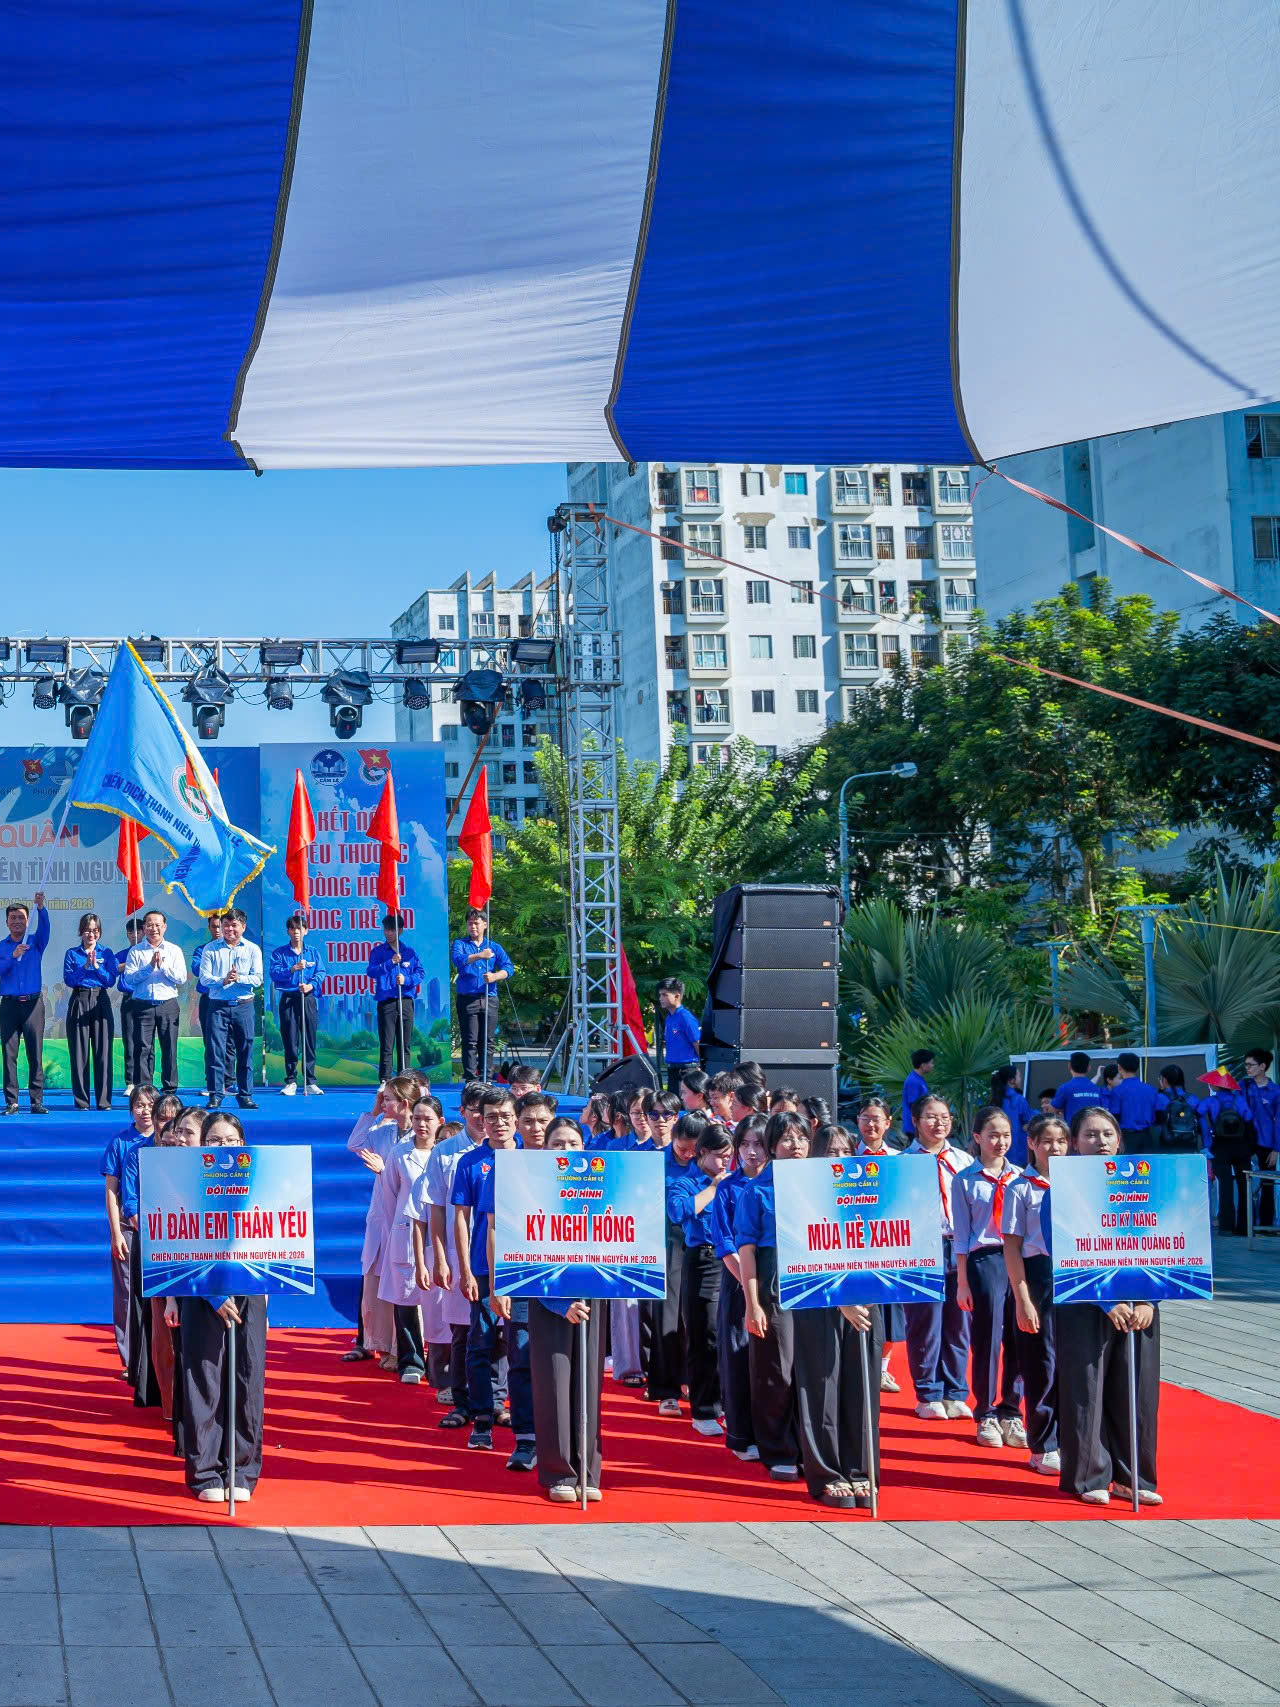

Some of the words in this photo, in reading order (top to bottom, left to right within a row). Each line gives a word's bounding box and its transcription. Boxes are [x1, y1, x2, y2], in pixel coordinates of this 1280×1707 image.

[145, 794, 174, 823] THANH
[172, 818, 194, 841] NIÊN
[318, 806, 350, 832] KẾT
[28, 857, 69, 881] TÌNH
[48, 898, 69, 910] năm
[71, 898, 94, 909] 2026
[348, 905, 381, 929] TRẺ
[206, 1185, 224, 1196] ĐỘI
[225, 1184, 249, 1194] HÌNH
[560, 1188, 578, 1200] ĐỘI
[579, 1188, 602, 1198] HÌNH
[836, 1195, 853, 1207] ĐỘI
[855, 1194, 878, 1204] HÌNH
[1109, 1192, 1125, 1204] ĐỘI
[1127, 1192, 1148, 1202] HÌNH
[148, 1207, 162, 1240] VÌ
[167, 1207, 199, 1239] ĐÀN
[205, 1212, 228, 1239] EM
[233, 1206, 273, 1239] THÂN
[278, 1206, 307, 1238] YÊU
[527, 1209, 545, 1241] KỲ
[551, 1206, 588, 1242] NGHỈ
[593, 1206, 634, 1243] HỒNG
[1102, 1214, 1116, 1227] CLB
[1120, 1211, 1131, 1226] KỸ
[1133, 1210, 1157, 1226] NĂNG
[808, 1217, 841, 1251] MÙA
[845, 1216, 864, 1249] HÈ
[869, 1220, 911, 1248] XANH
[1076, 1233, 1091, 1251] THỦ
[1094, 1234, 1112, 1250] LĨNH
[1115, 1234, 1138, 1250] KHĂN
[1142, 1235, 1170, 1251] QUÀNG
[1173, 1232, 1185, 1249] ĐỎ
[191, 1252, 212, 1260] THANH
[215, 1251, 231, 1260] NIÊN
[289, 1251, 304, 1259] 2026
[544, 1254, 565, 1263] THANH
[567, 1252, 583, 1262] NIÊN
[641, 1256, 656, 1264] 2026
[1096, 1259, 1116, 1267] THANH
[1118, 1257, 1133, 1266] NIÊN
[825, 1263, 845, 1271] THANH
[847, 1261, 863, 1270] NIÊN
[920, 1259, 935, 1267] 2026
